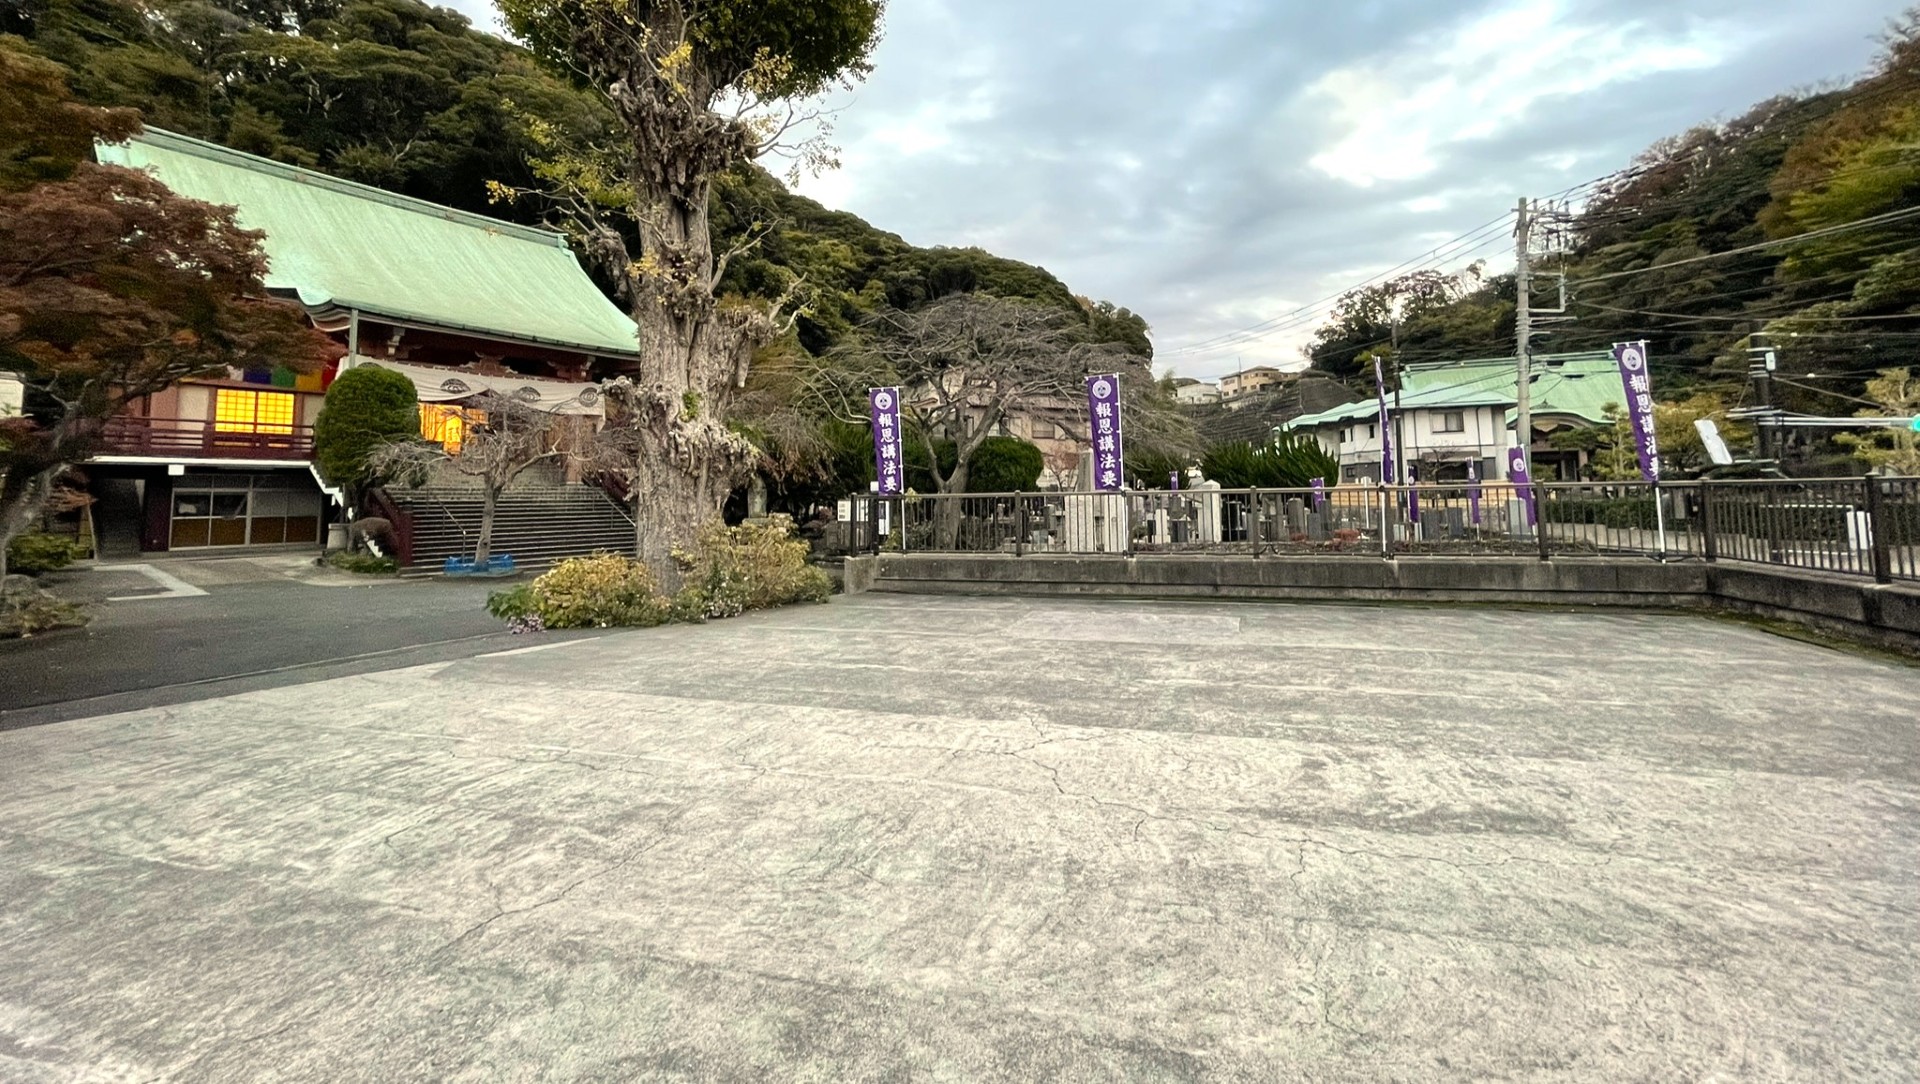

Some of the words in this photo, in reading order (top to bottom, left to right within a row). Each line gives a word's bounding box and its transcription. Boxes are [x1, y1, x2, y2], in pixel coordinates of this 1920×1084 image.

[878, 412, 897, 491] 報恩講法要
[1095, 401, 1118, 487] 報恩講法要
